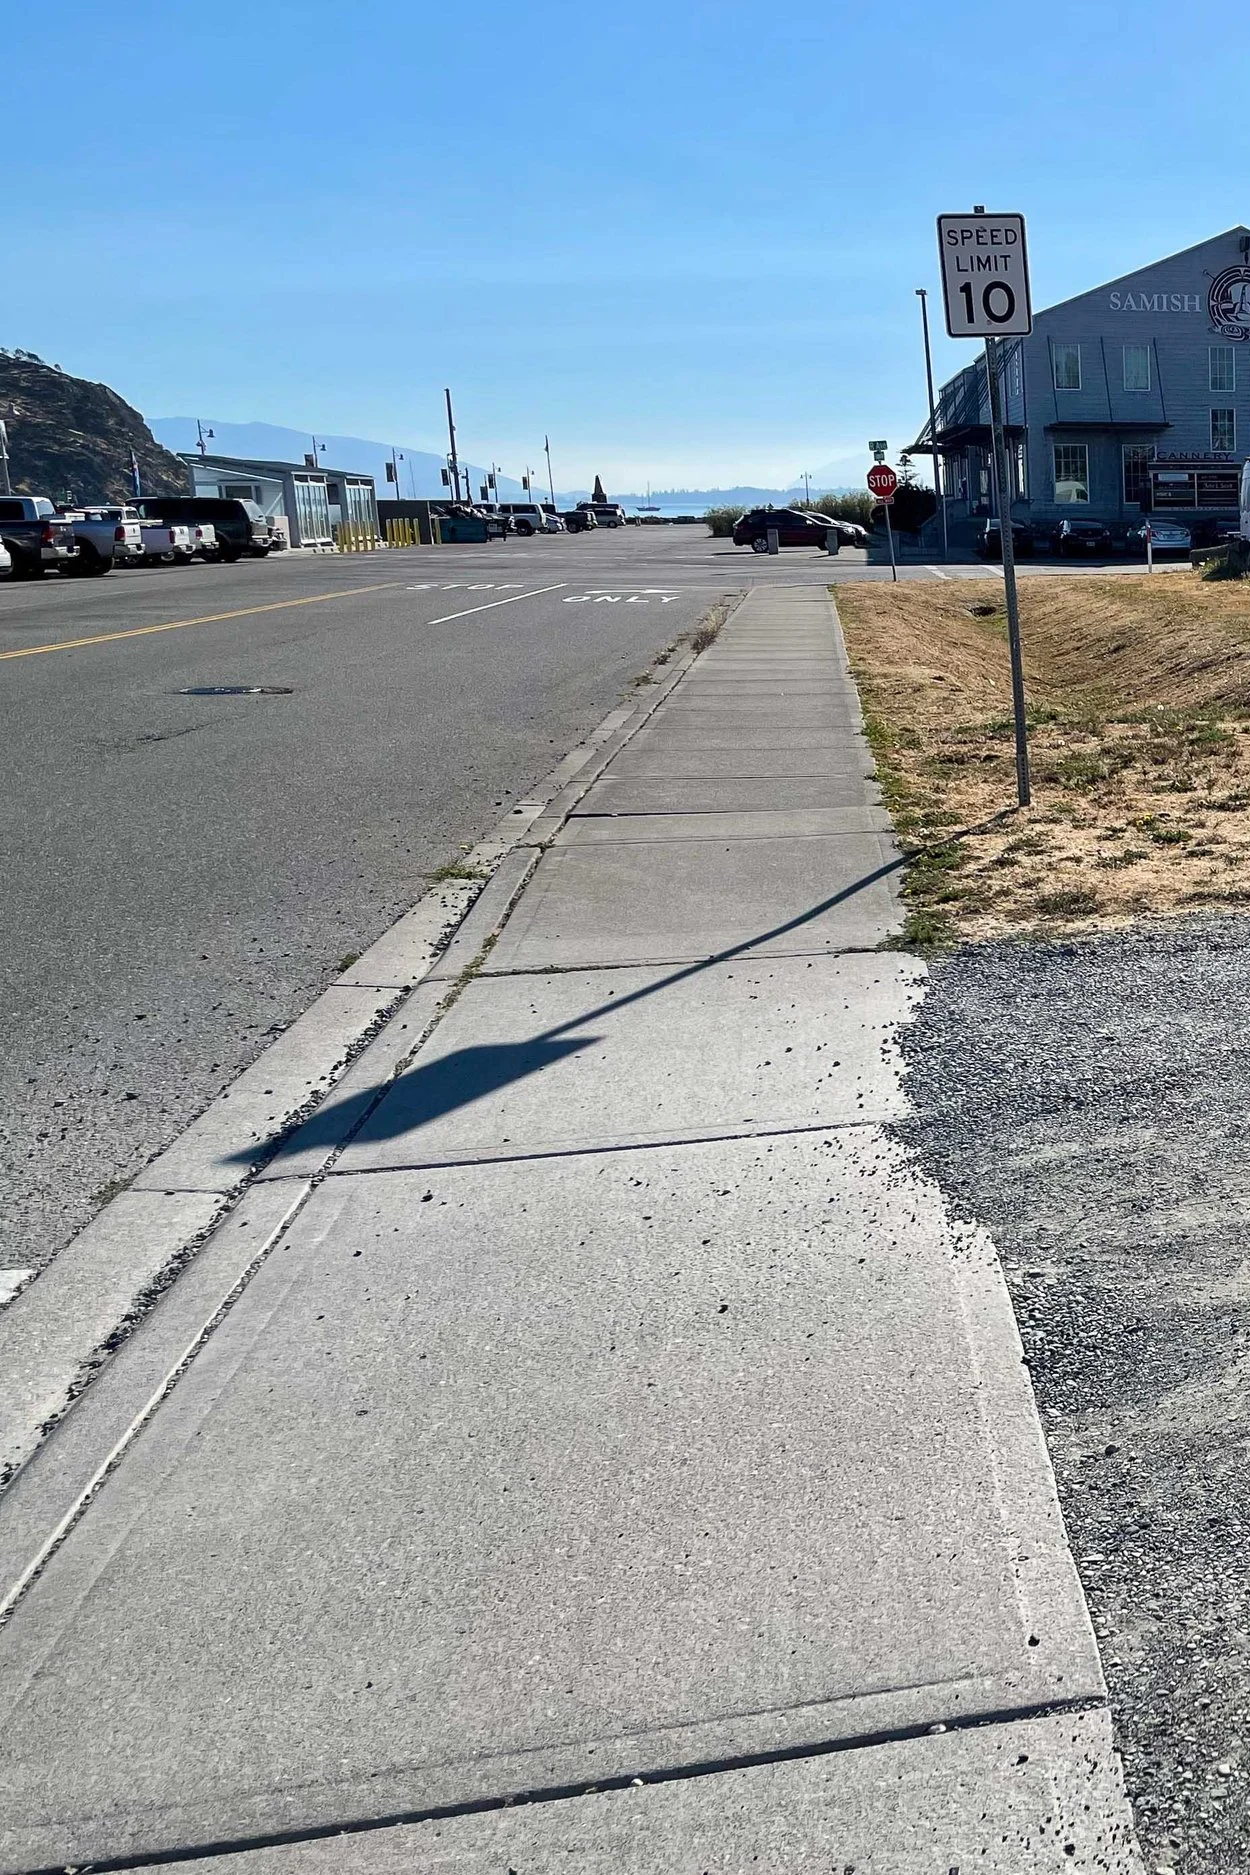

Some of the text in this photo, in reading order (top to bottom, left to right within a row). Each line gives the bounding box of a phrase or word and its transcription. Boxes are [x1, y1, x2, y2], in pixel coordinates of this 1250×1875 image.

[947, 229, 1017, 246] SPEED
[956, 255, 1011, 272] LIMIT
[959, 281, 1016, 324] 10
[1109, 292, 1202, 313] SAMISH
[1157, 451, 1231, 460] CANNERY
[869, 474, 895, 488] STOP
